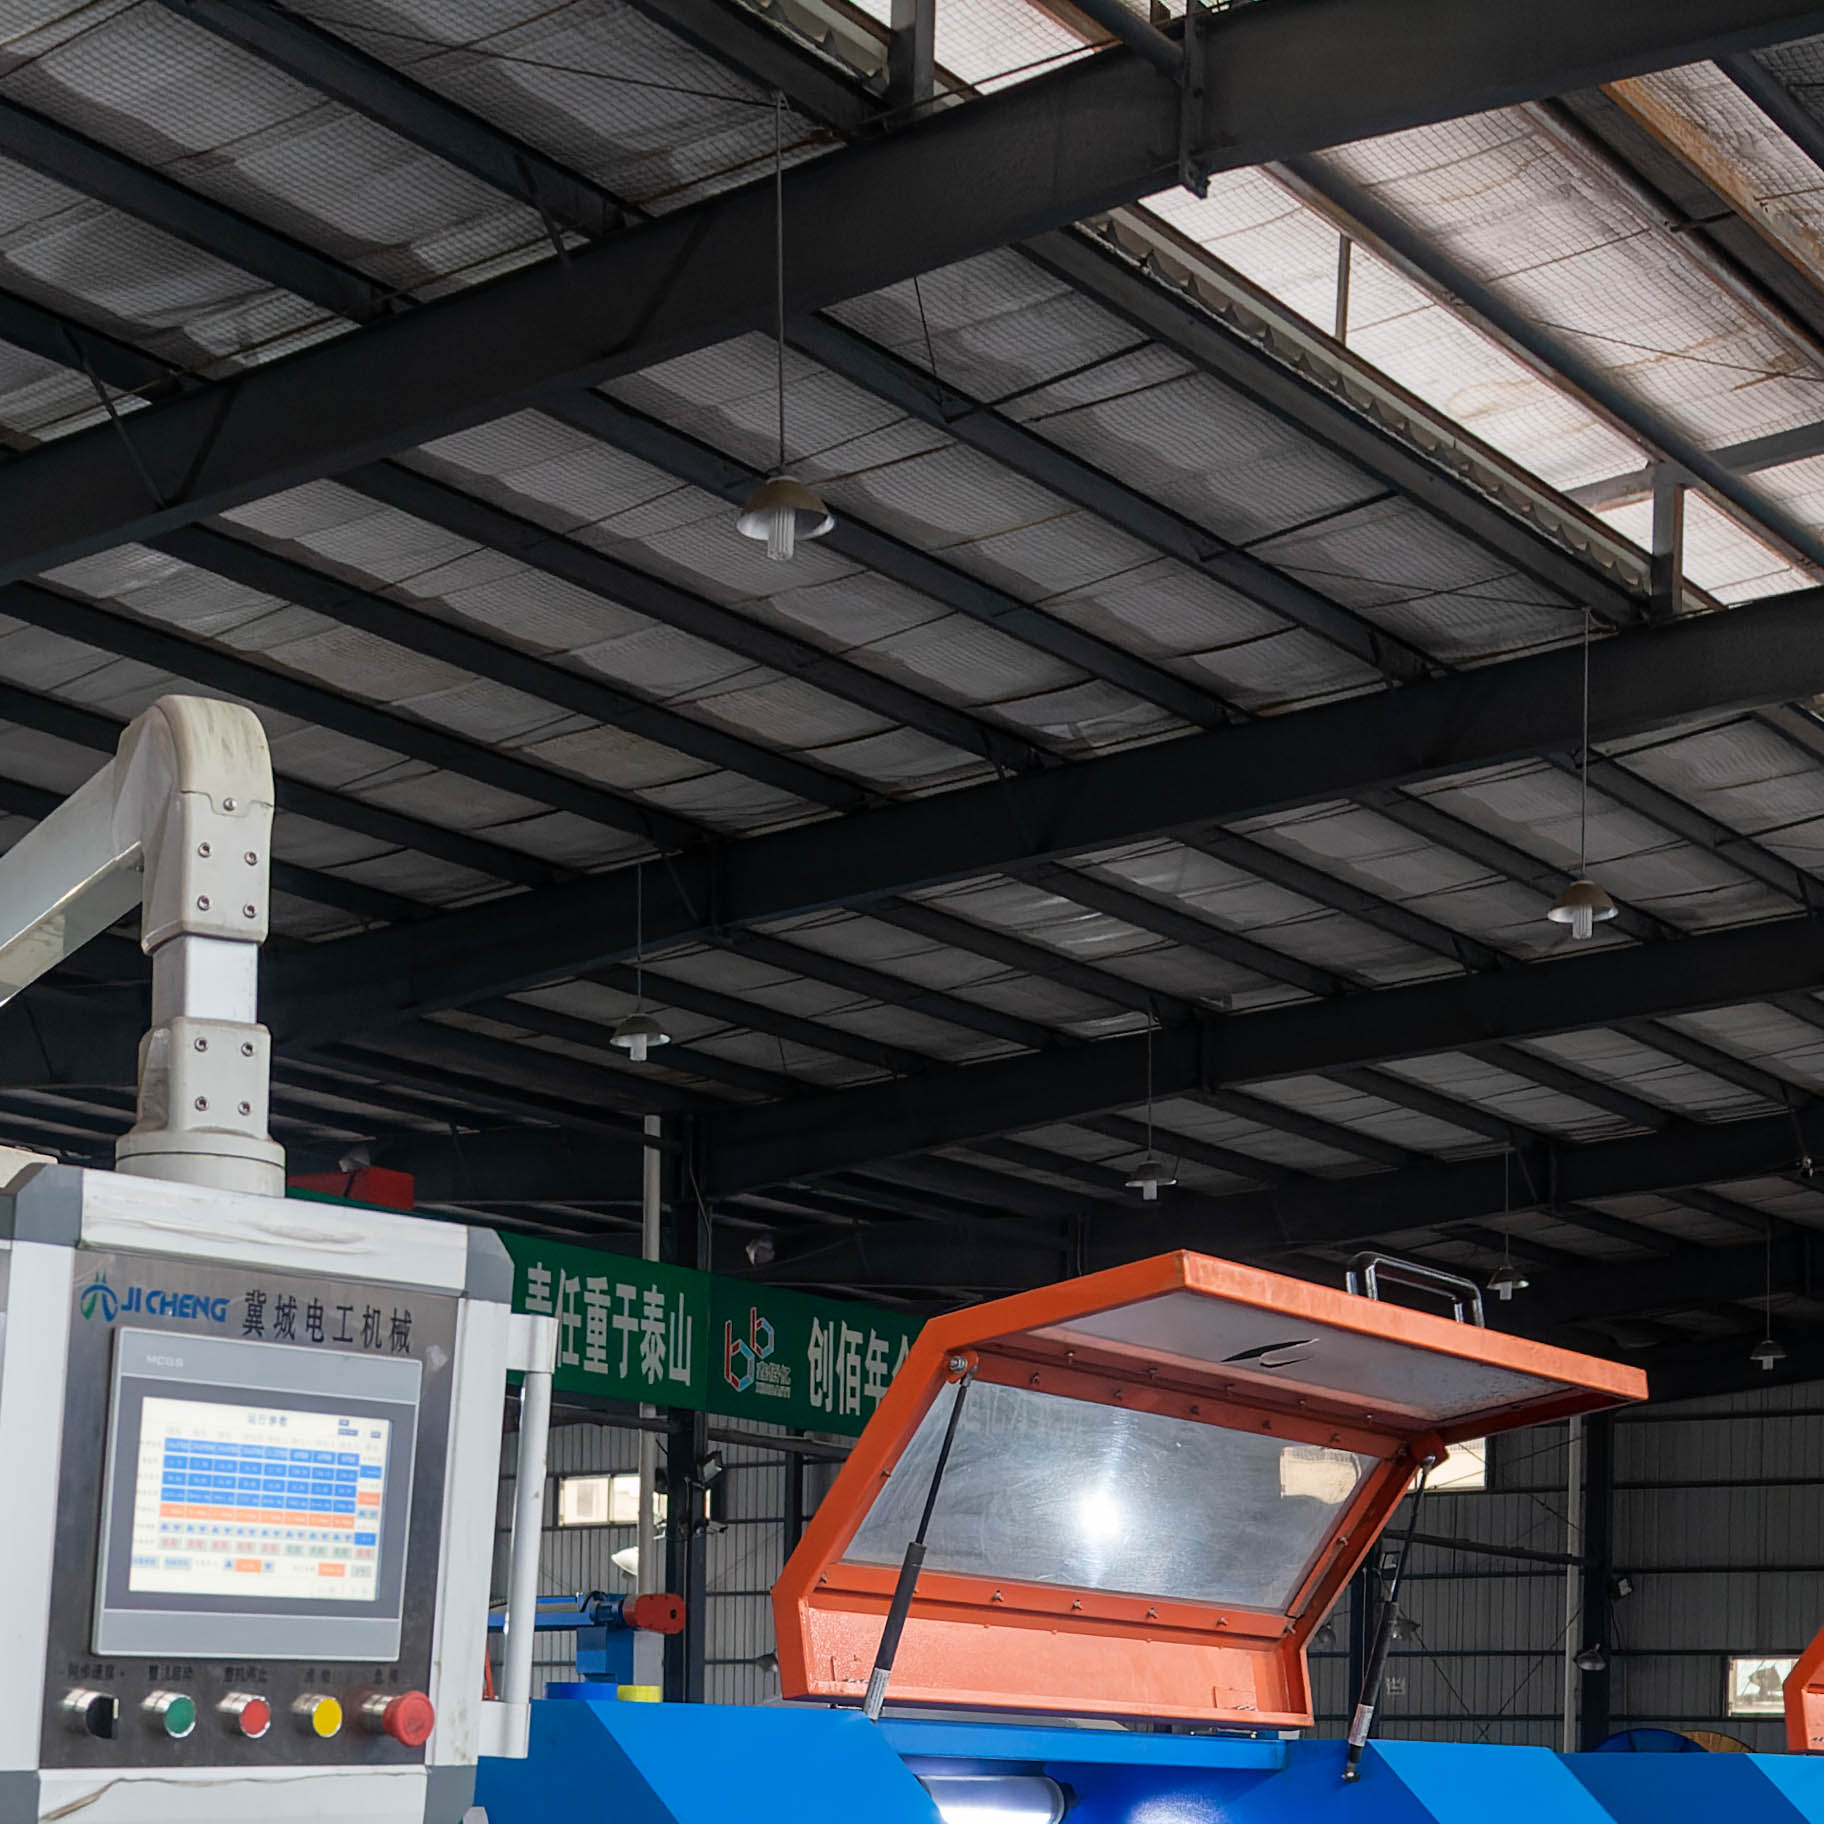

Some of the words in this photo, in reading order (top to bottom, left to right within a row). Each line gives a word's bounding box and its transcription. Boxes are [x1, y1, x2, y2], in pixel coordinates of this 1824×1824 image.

[145, 1289, 230, 1322] CHENG
[242, 1289, 412, 1354] 冀城电工机械
[808, 1316, 909, 1416] 创佰年
